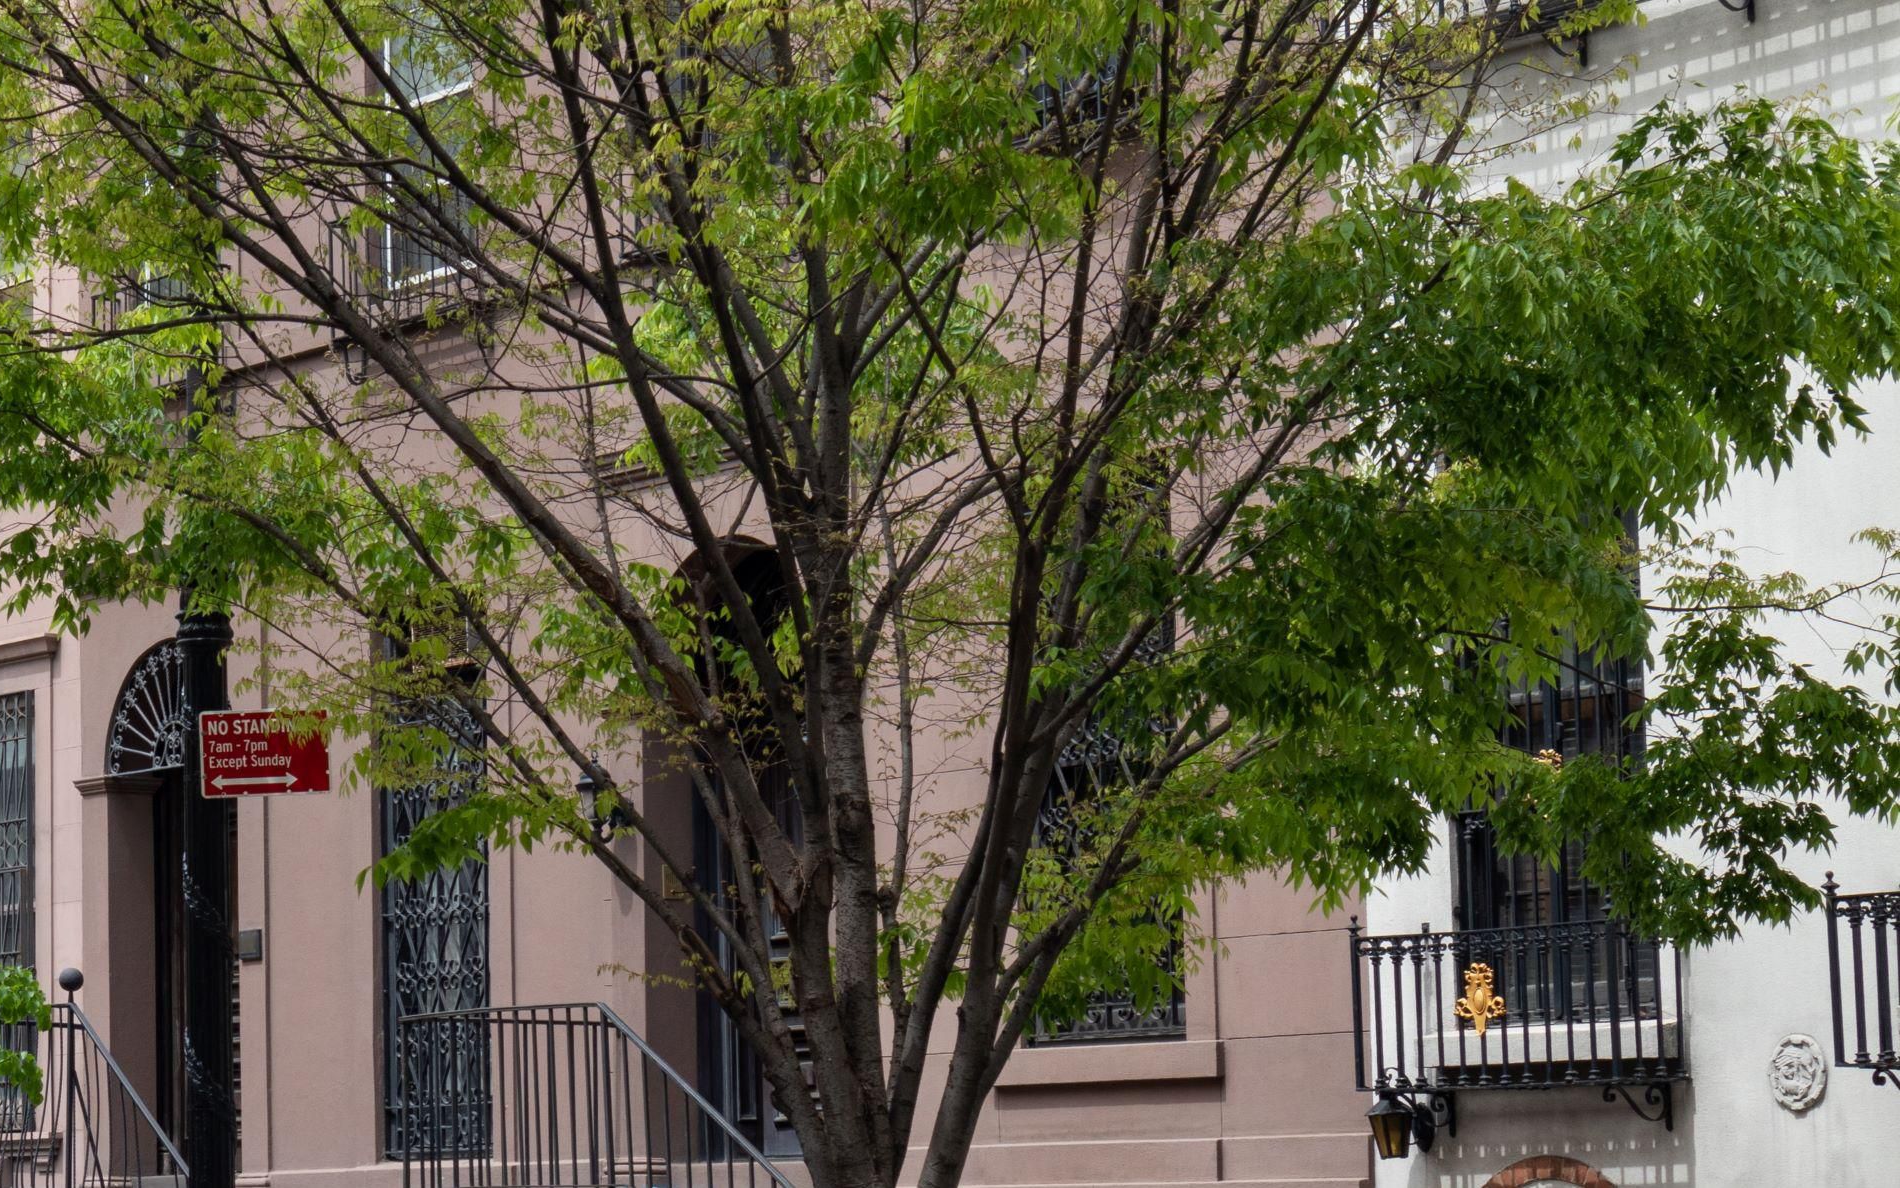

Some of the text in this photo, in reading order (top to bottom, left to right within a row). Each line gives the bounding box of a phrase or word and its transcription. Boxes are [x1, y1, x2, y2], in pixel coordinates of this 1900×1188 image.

[207, 718, 297, 736] NO STANDIN
[208, 741, 233, 753] 7am
[244, 739, 268, 754] 7pm
[209, 754, 292, 770] Except Sunday
